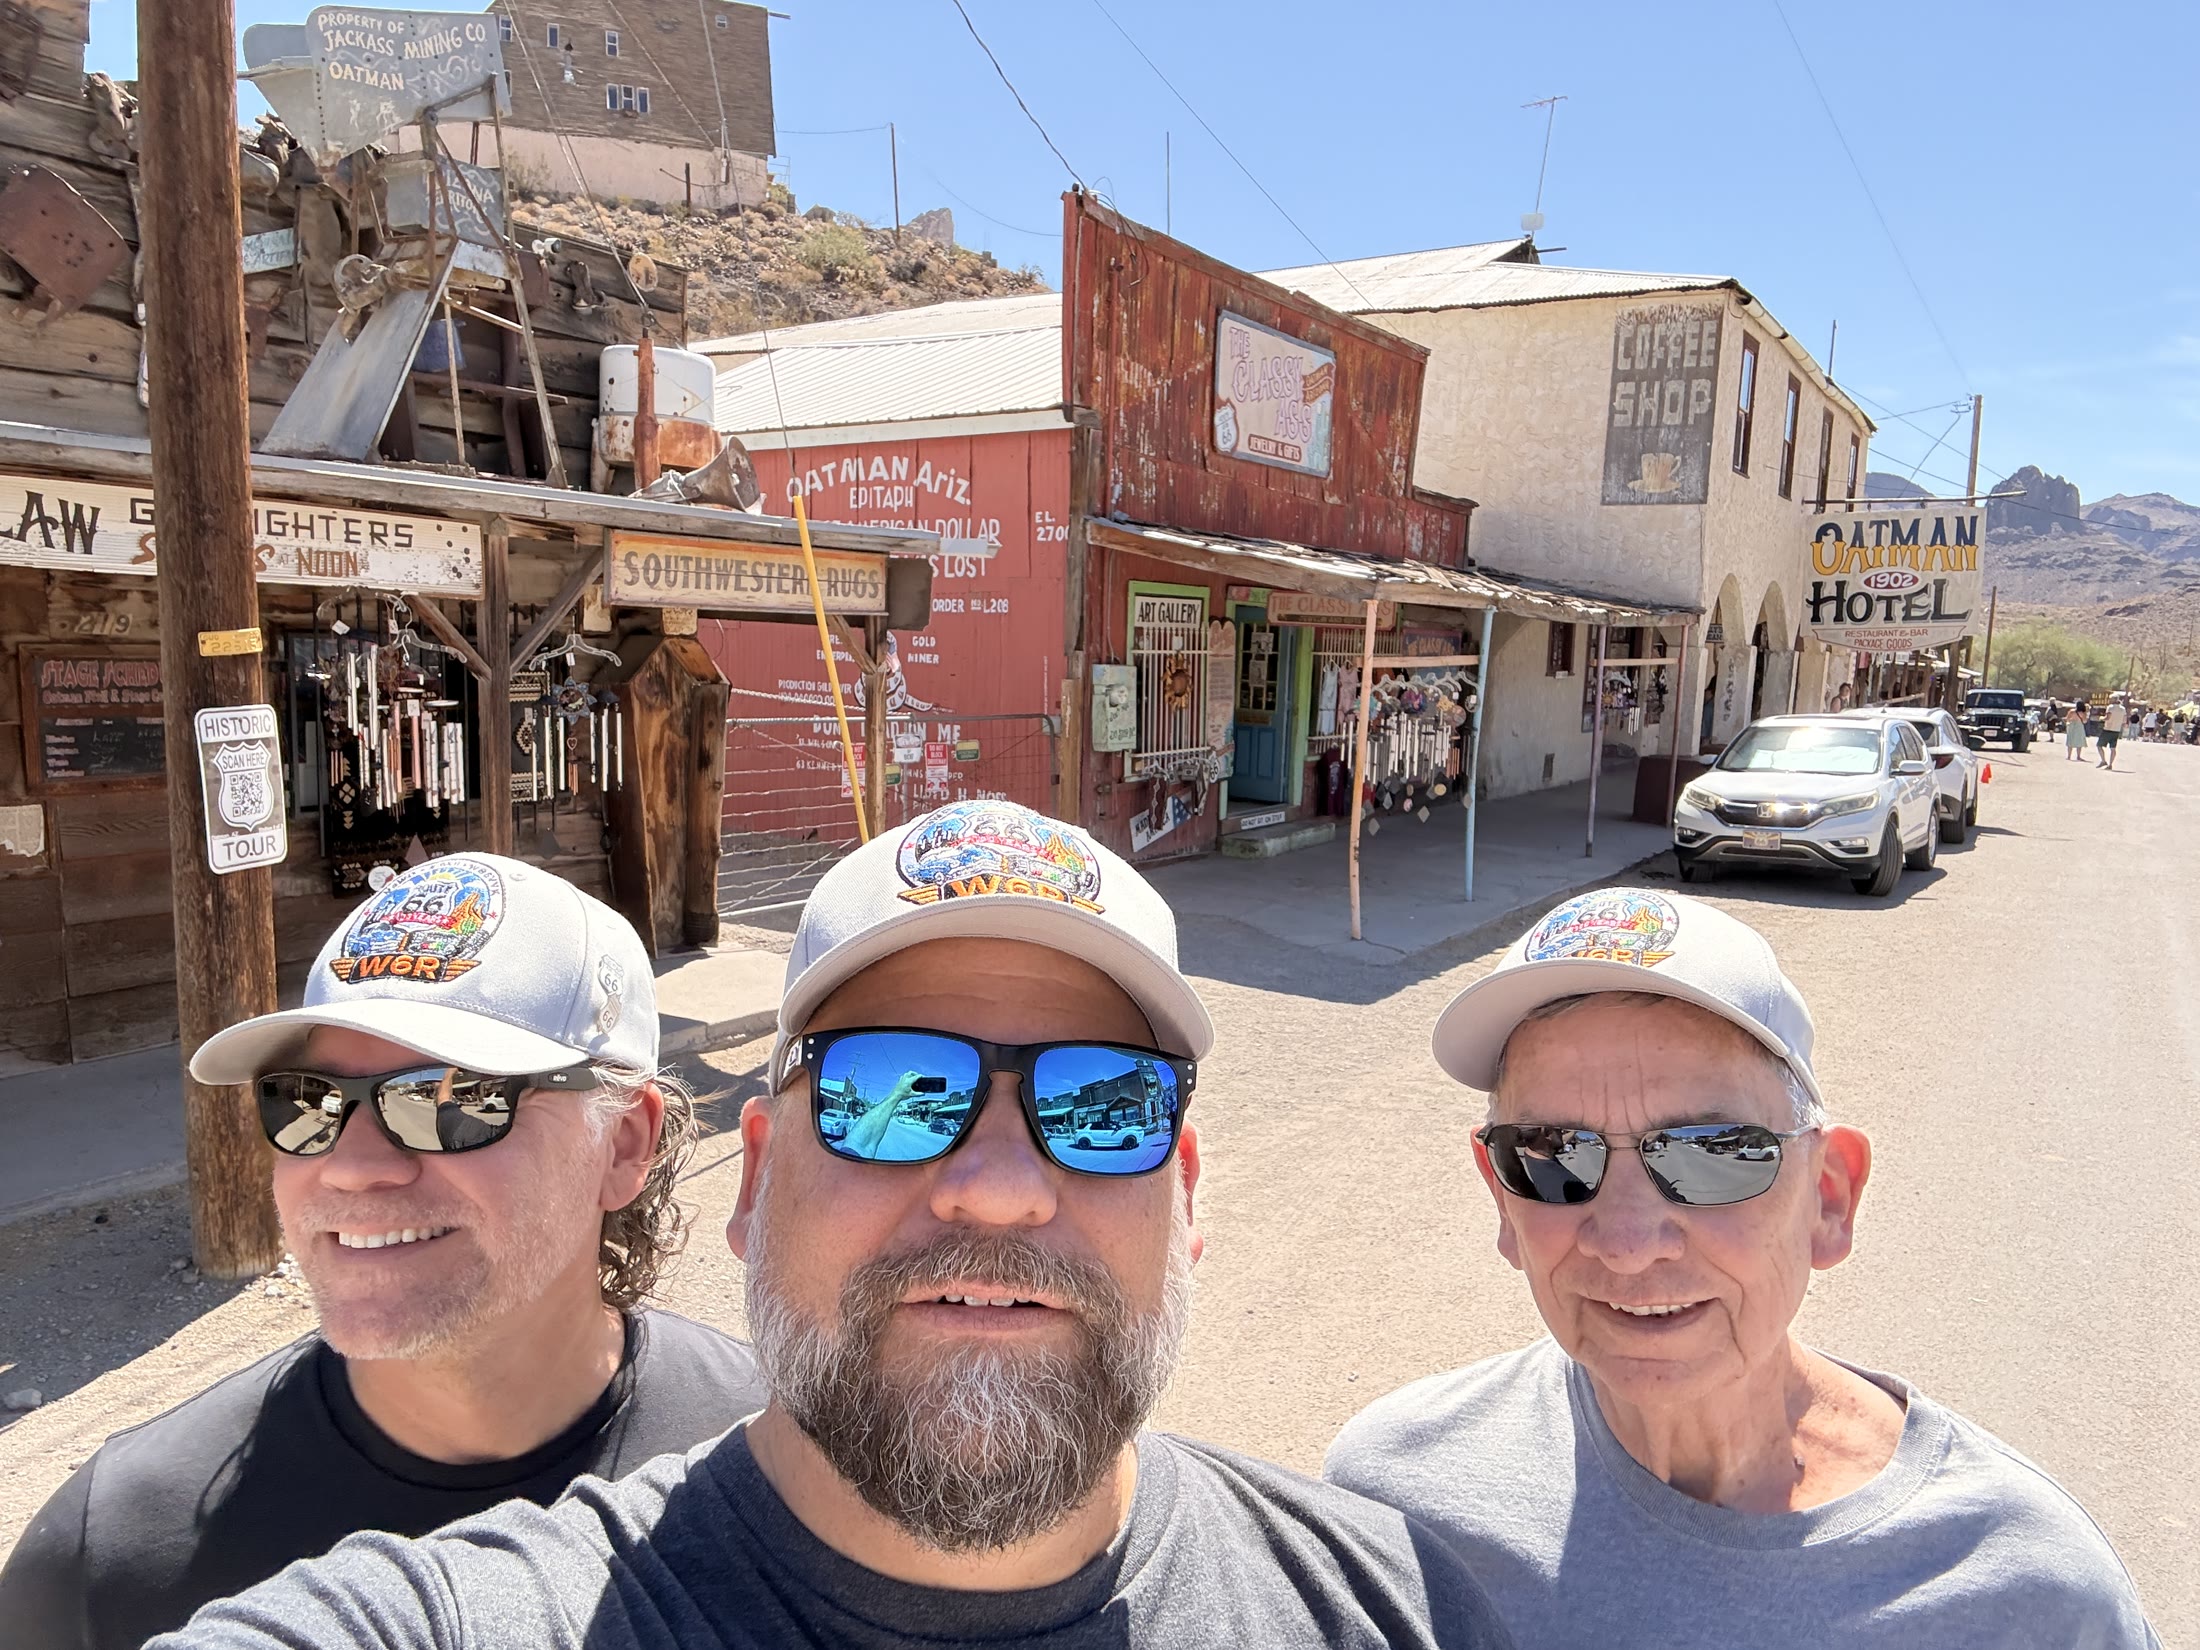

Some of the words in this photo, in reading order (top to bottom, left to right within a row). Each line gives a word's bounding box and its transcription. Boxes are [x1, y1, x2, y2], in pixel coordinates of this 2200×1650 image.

[317, 13, 383, 32] PROPERTY
[387, 21, 405, 34] OF
[324, 29, 394, 57] JACKASS
[404, 27, 462, 59] MINING
[328, 61, 404, 91] OATMAN
[1617, 320, 1718, 371] COFFEE
[1232, 355, 1304, 402] CLASSY
[1613, 378, 1712, 428] SHOP
[1274, 396, 1313, 444] ASS
[786, 455, 909, 503] OATMAN
[850, 486, 914, 512] EPITAPH
[1810, 515, 1979, 576] OATMAN
[297, 547, 358, 577] NOON
[944, 554, 986, 579] LOST
[827, 567, 880, 599] RUGS
[1870, 573, 1915, 588] 1902
[932, 598, 965, 613] ORDER
[1137, 602, 1156, 623] ART
[1158, 602, 1200, 624] GALLERY
[1806, 578, 1974, 624] HOTEL
[912, 636, 936, 647] GOLD
[1845, 629, 1898, 638] RESTAURANT
[1910, 628, 1929, 637] BAR
[1854, 639, 1884, 648] PACKAGE
[1886, 638, 1913, 650] GOODS
[907, 653, 939, 665] MINER
[41, 660, 99, 689] STAGE
[103, 660, 163, 689] SCHED
[204, 714, 271, 738] HISTORIC
[222, 754, 246, 770] SCAN
[247, 752, 265, 767] HERE
[222, 835, 276, 861] TOUR
[402, 894, 446, 916] 66
[360, 955, 440, 980] W6R
[604, 973, 618, 992] 66
[602, 1010, 614, 1029] 66
